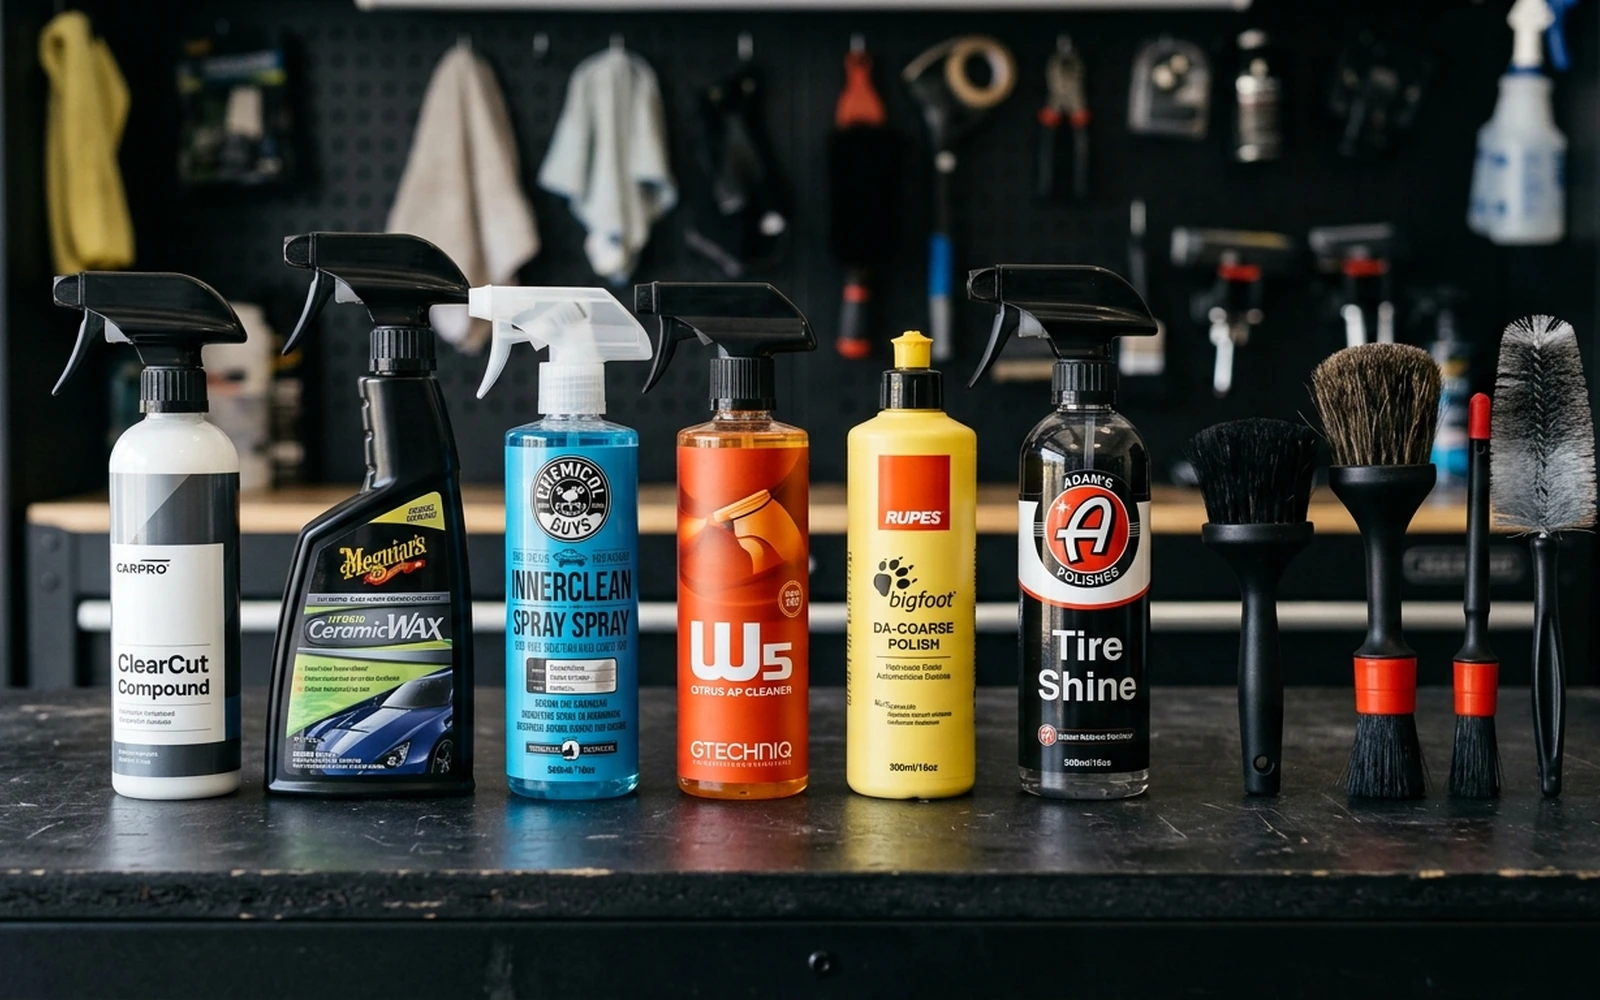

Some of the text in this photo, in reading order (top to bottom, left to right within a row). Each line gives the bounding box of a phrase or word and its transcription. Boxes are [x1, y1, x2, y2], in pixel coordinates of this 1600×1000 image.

[885, 510, 942, 524] RUPES
[339, 534, 427, 580] Meguiar's
[116, 563, 168, 575] CARPRO
[512, 569, 632, 602] INNERCLEAN
[889, 590, 955, 613] bigfoot
[513, 609, 630, 638] SPRAY SPRAY
[873, 622, 955, 635] DA-COARSE
[1052, 629, 1123, 661] Tire
[118, 653, 209, 674] ClearCut
[118, 678, 210, 700] Compound
[727, 686, 743, 697] AP
[745, 685, 792, 697] CLEANER
[1038, 669, 1137, 701] Shine
[690, 740, 793, 760] GTECHNIQ
